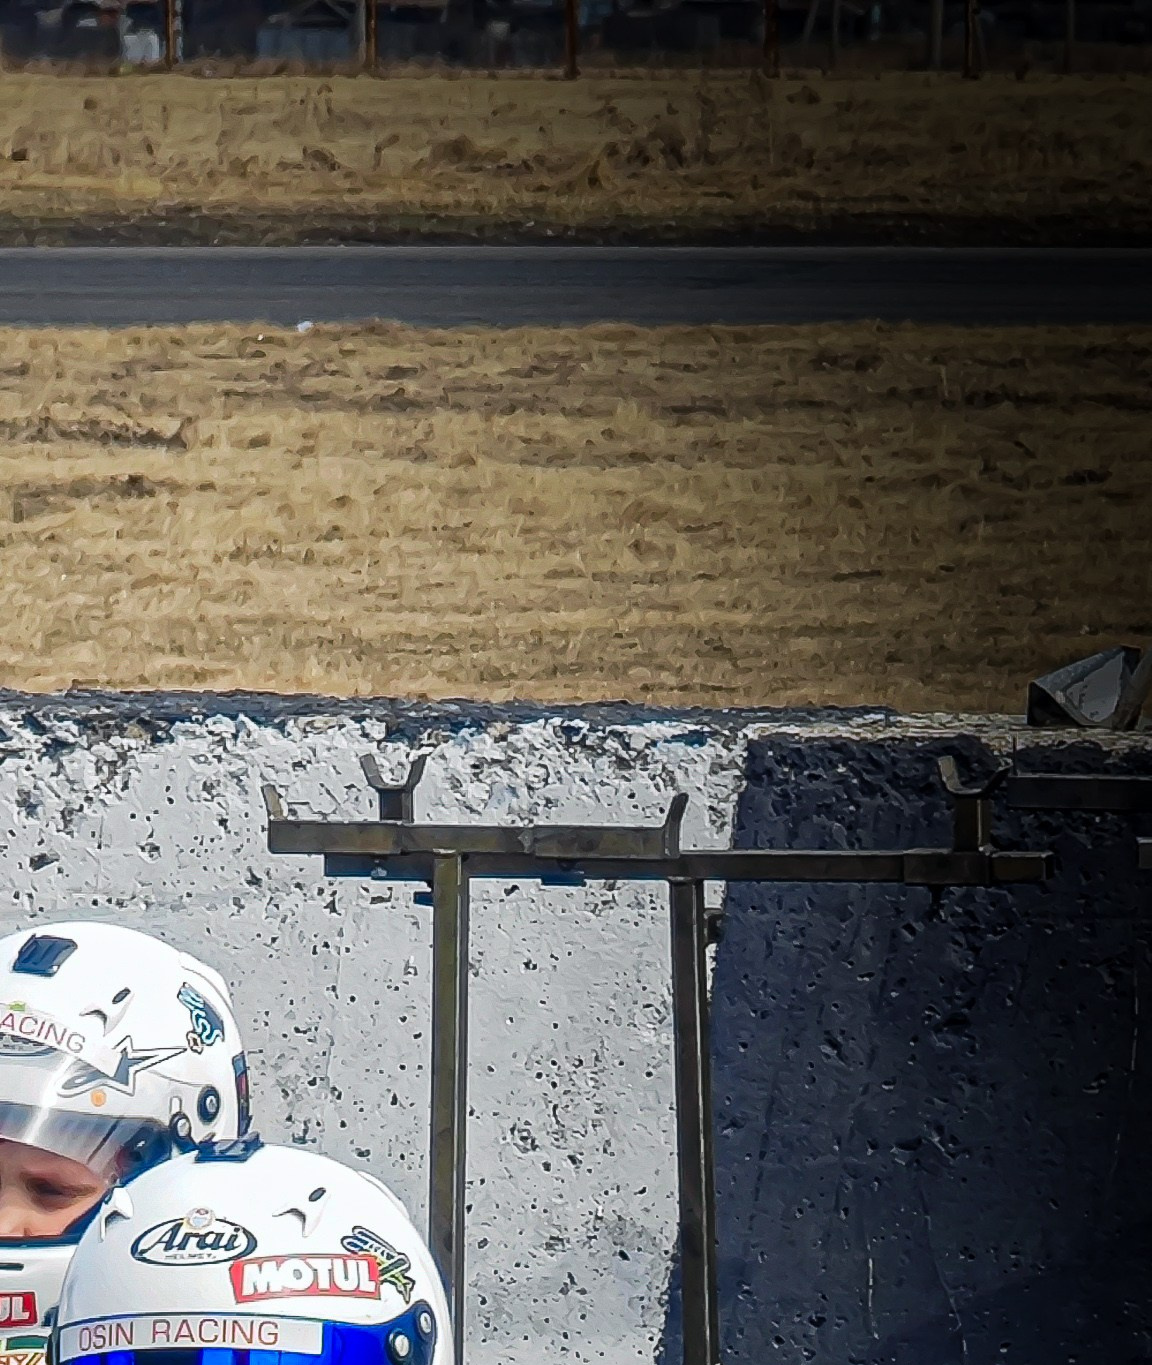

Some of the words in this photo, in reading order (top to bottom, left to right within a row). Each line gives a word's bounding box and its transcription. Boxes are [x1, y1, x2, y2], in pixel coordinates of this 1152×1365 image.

[145, 1221, 243, 1252] Arai
[241, 1258, 377, 1296] MOTUL
[78, 1320, 135, 1352] OSIN
[151, 1317, 279, 1346] RACING
